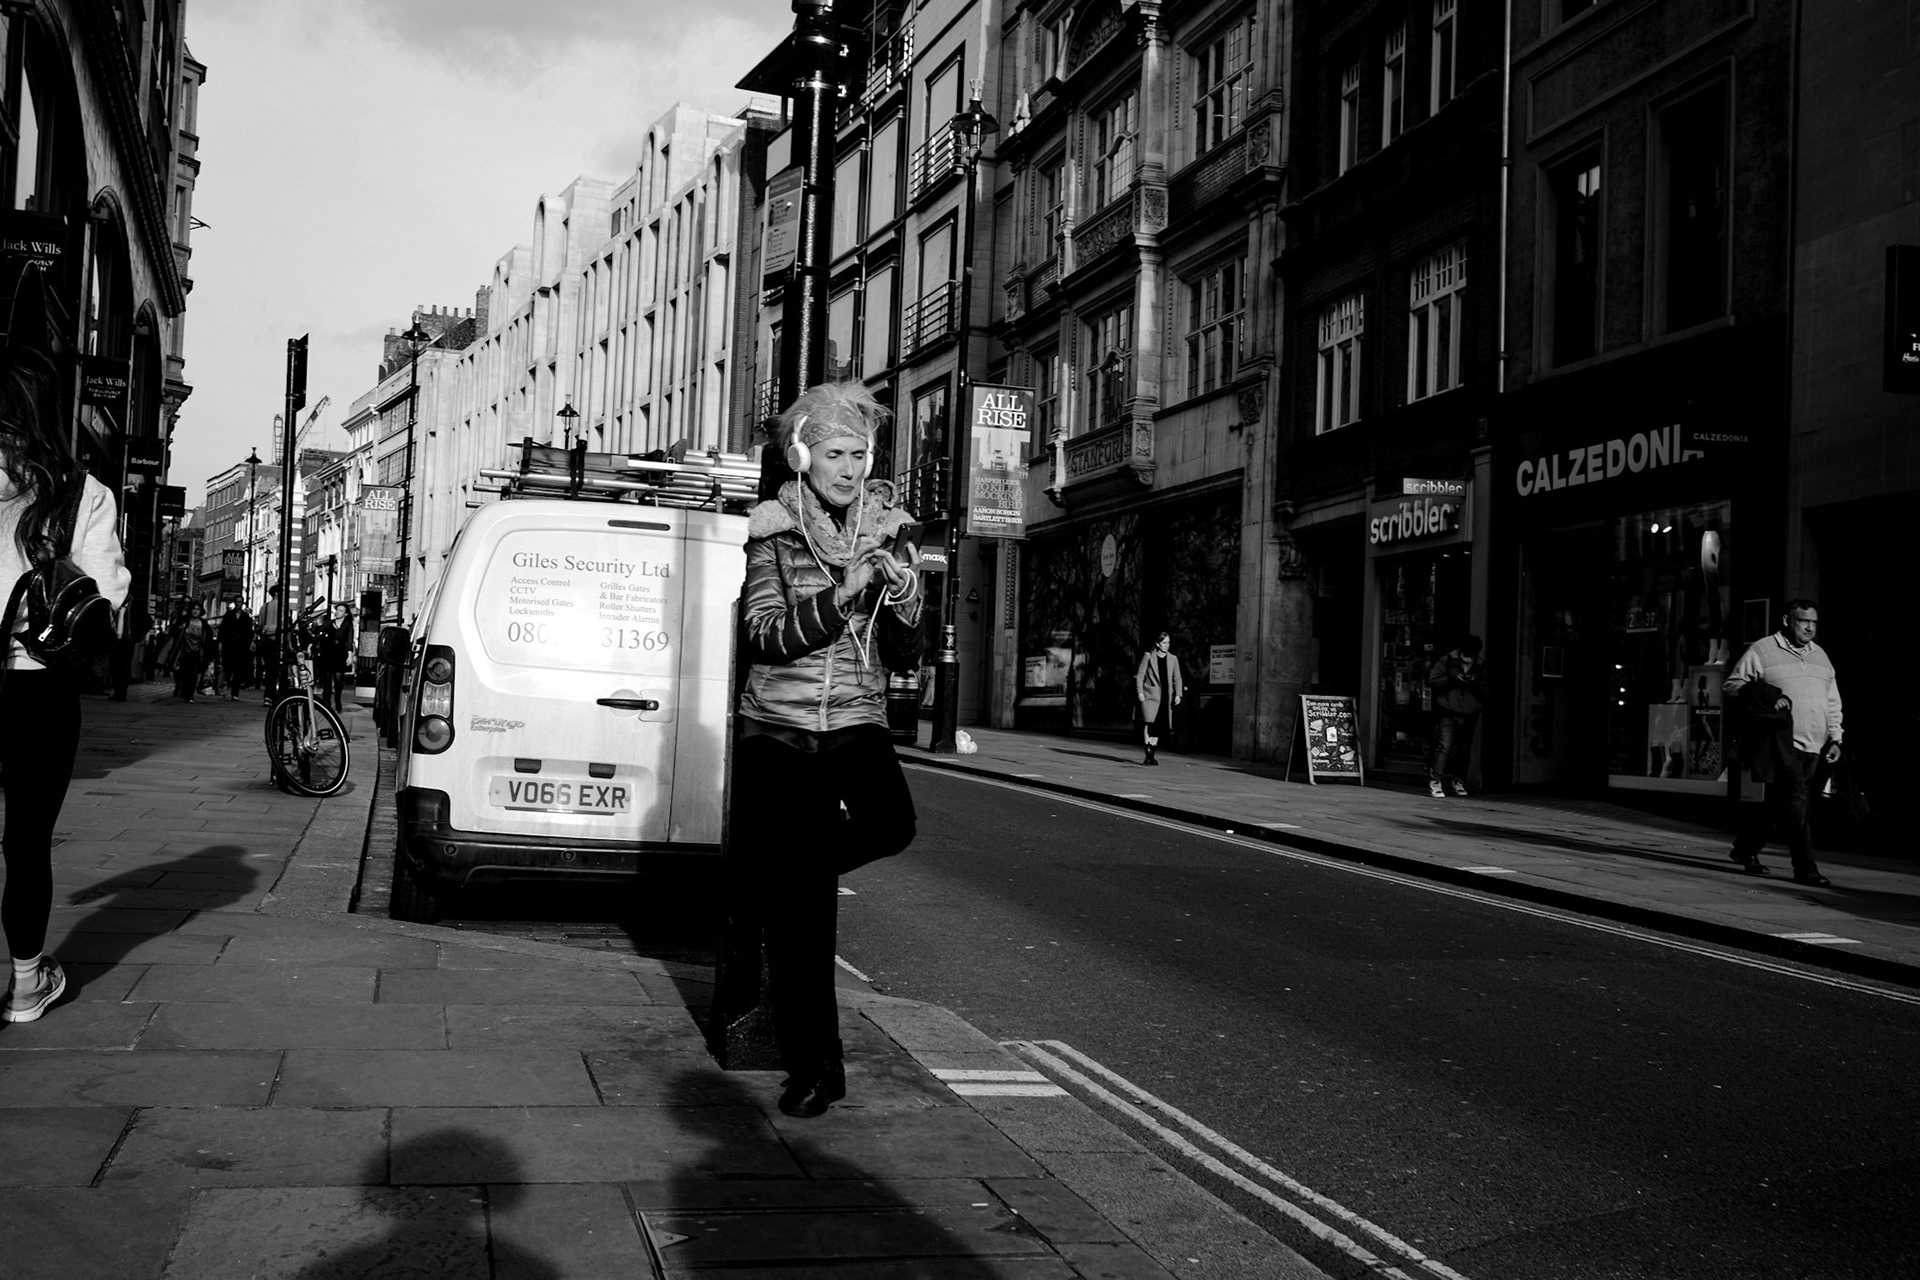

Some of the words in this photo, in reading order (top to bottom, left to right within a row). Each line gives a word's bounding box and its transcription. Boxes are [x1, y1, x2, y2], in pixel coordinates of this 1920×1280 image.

[0, 238, 27, 252] Jack
[31, 241, 62, 255] Wills
[84, 375, 103, 386] Jack
[105, 377, 127, 387] Wills
[981, 393, 1024, 412] ALL
[976, 408, 1027, 429] RISE
[1693, 431, 1749, 443] CALZEDONIA
[131, 457, 160, 466] Barbour
[1406, 480, 1464, 494] scribbler
[366, 489, 394, 500] ALL
[974, 490, 1023, 502] MOCKING
[364, 499, 396, 510] RISE
[998, 500, 1023, 510] BIRD
[512, 552, 558, 570] Giles
[564, 555, 636, 578] Security
[641, 561, 671, 578] Ltd
[510, 576, 539, 585] Access
[540, 577, 571, 587] Control
[600, 581, 626, 591] Grilles
[628, 584, 651, 593] Gates
[510, 586, 537, 595] CCTV
[509, 596, 550, 607] Motorised
[551, 598, 575, 608] Gates
[599, 592, 608, 600] &
[609, 592, 624, 601] Bar
[625, 593, 668, 605] Fabricators
[509, 606, 555, 617] Locksmiths
[599, 602, 624, 611] Roller
[625, 603, 657, 614] Shutters
[599, 612, 630, 622] Intruder
[631, 614, 661, 625] Alarms
[507, 620, 550, 645] 080
[579, 784, 626, 809] EXR
